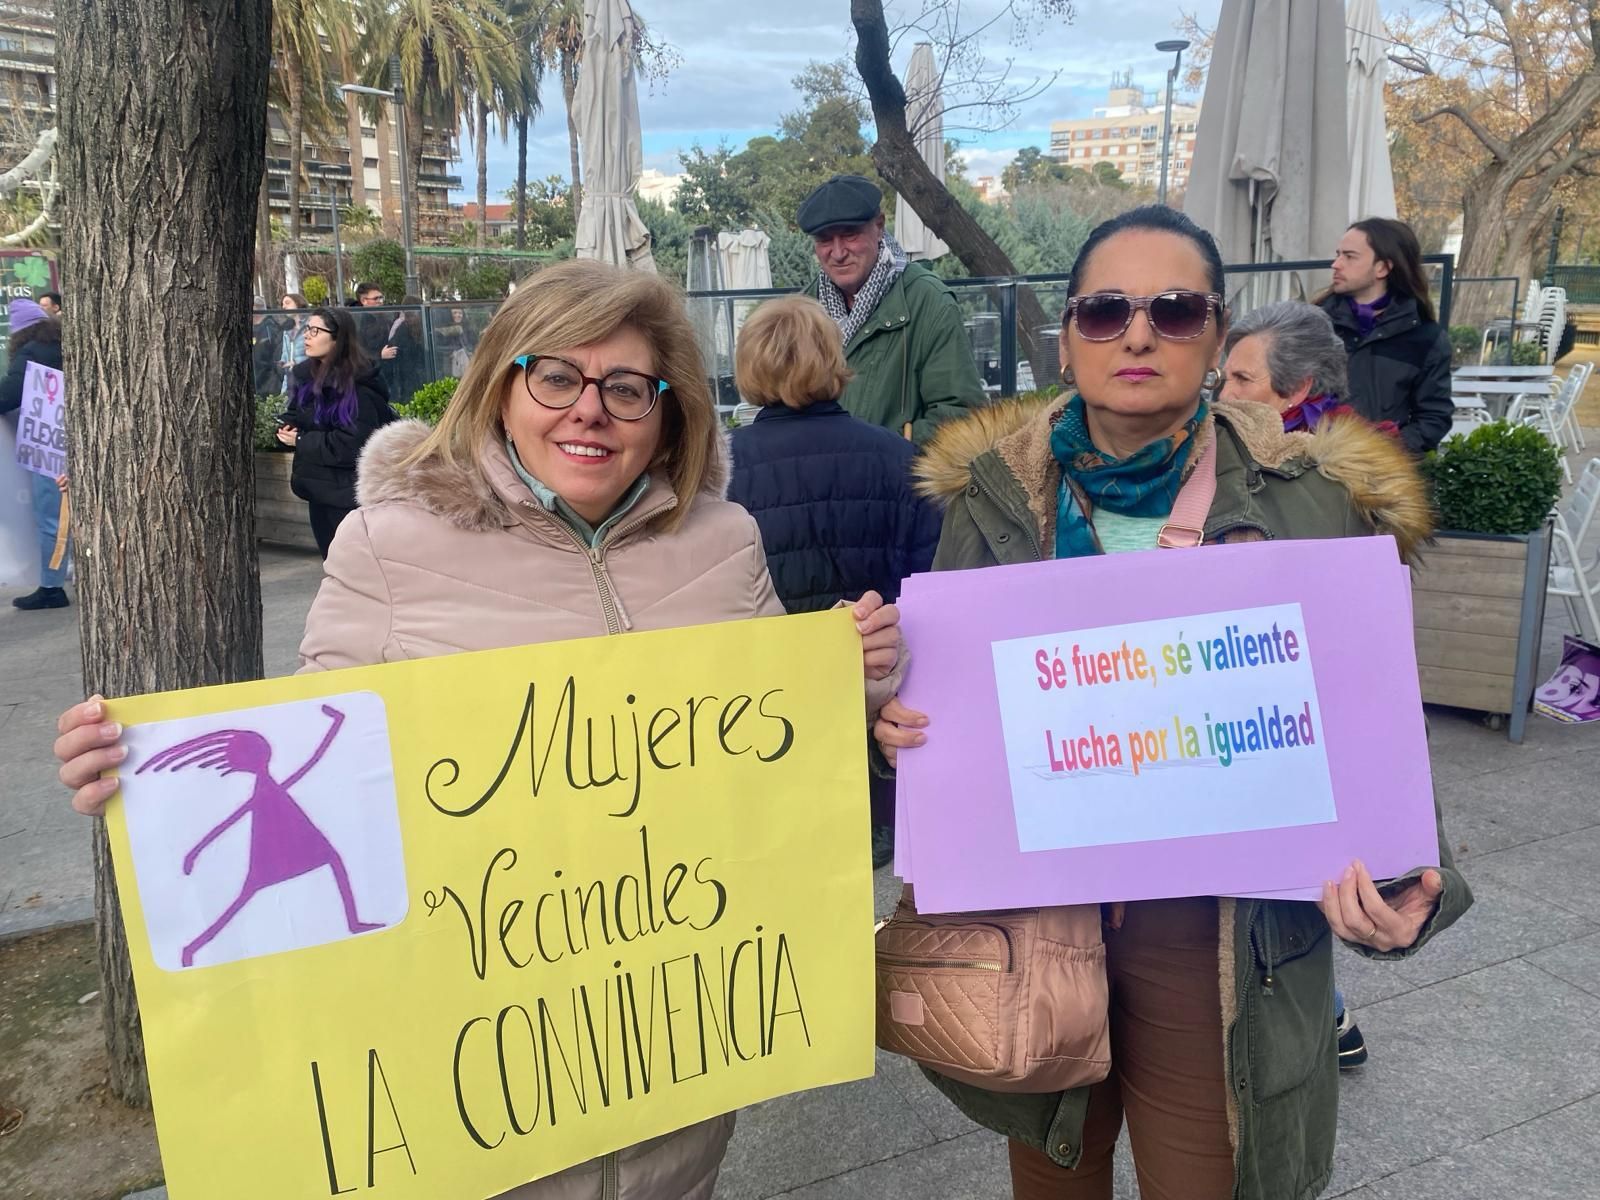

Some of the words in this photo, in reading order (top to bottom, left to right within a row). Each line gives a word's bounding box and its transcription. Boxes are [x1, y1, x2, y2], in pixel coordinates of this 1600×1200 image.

[1035, 647, 1067, 691] Sé
[1072, 640, 1157, 688] fuerte,
[1162, 631, 1192, 676] sé
[1197, 622, 1300, 671] valiente
[425, 675, 795, 817] Mujeres
[1046, 722, 1123, 772] Lucha
[1128, 728, 1168, 776] por
[1174, 715, 1201, 759] la
[1204, 701, 1316, 767] igualdad
[424, 825, 727, 980] Vecinales
[311, 1048, 417, 1195] LA
[453, 925, 812, 1150] CONVIVENCIA
